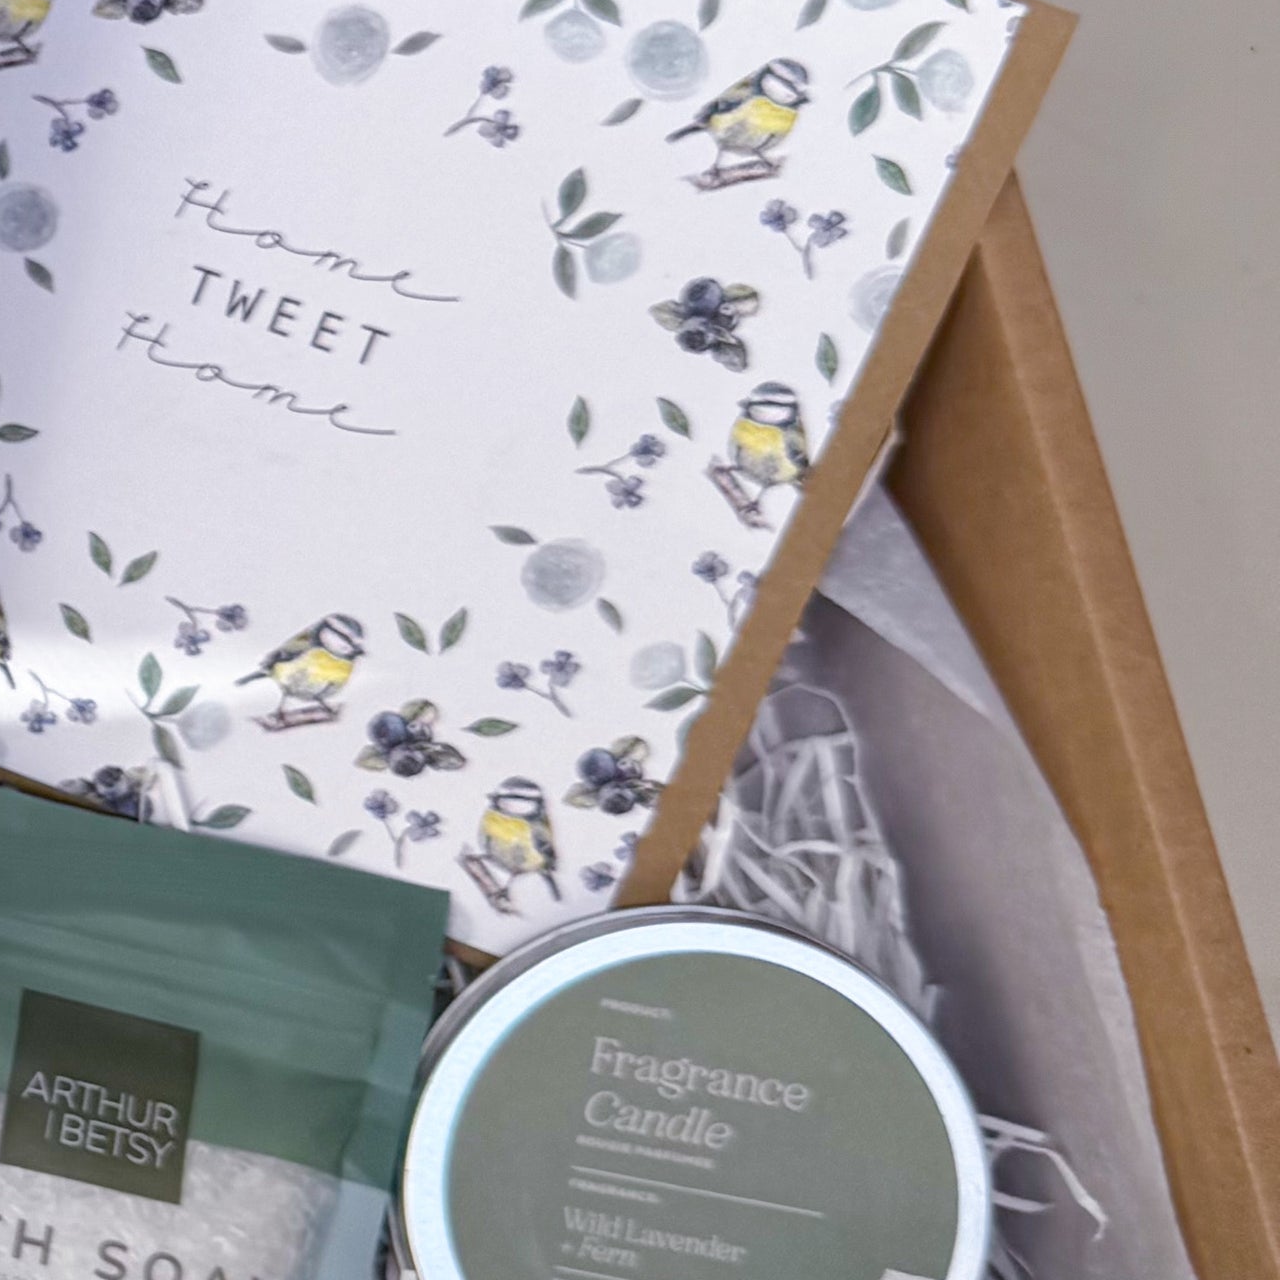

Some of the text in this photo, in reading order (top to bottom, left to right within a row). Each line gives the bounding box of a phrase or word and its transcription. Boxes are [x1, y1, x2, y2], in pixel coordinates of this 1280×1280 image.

[175, 177, 460, 302] Home
[192, 265, 391, 365] TWEET
[116, 311, 397, 436] Home
[20, 1070, 178, 1138] ARTHUR
[591, 1036, 811, 1112] Fragrance
[58, 1112, 175, 1169] BETSY
[583, 1090, 735, 1149] Candle
[563, 1206, 747, 1262] Wild Lavender
